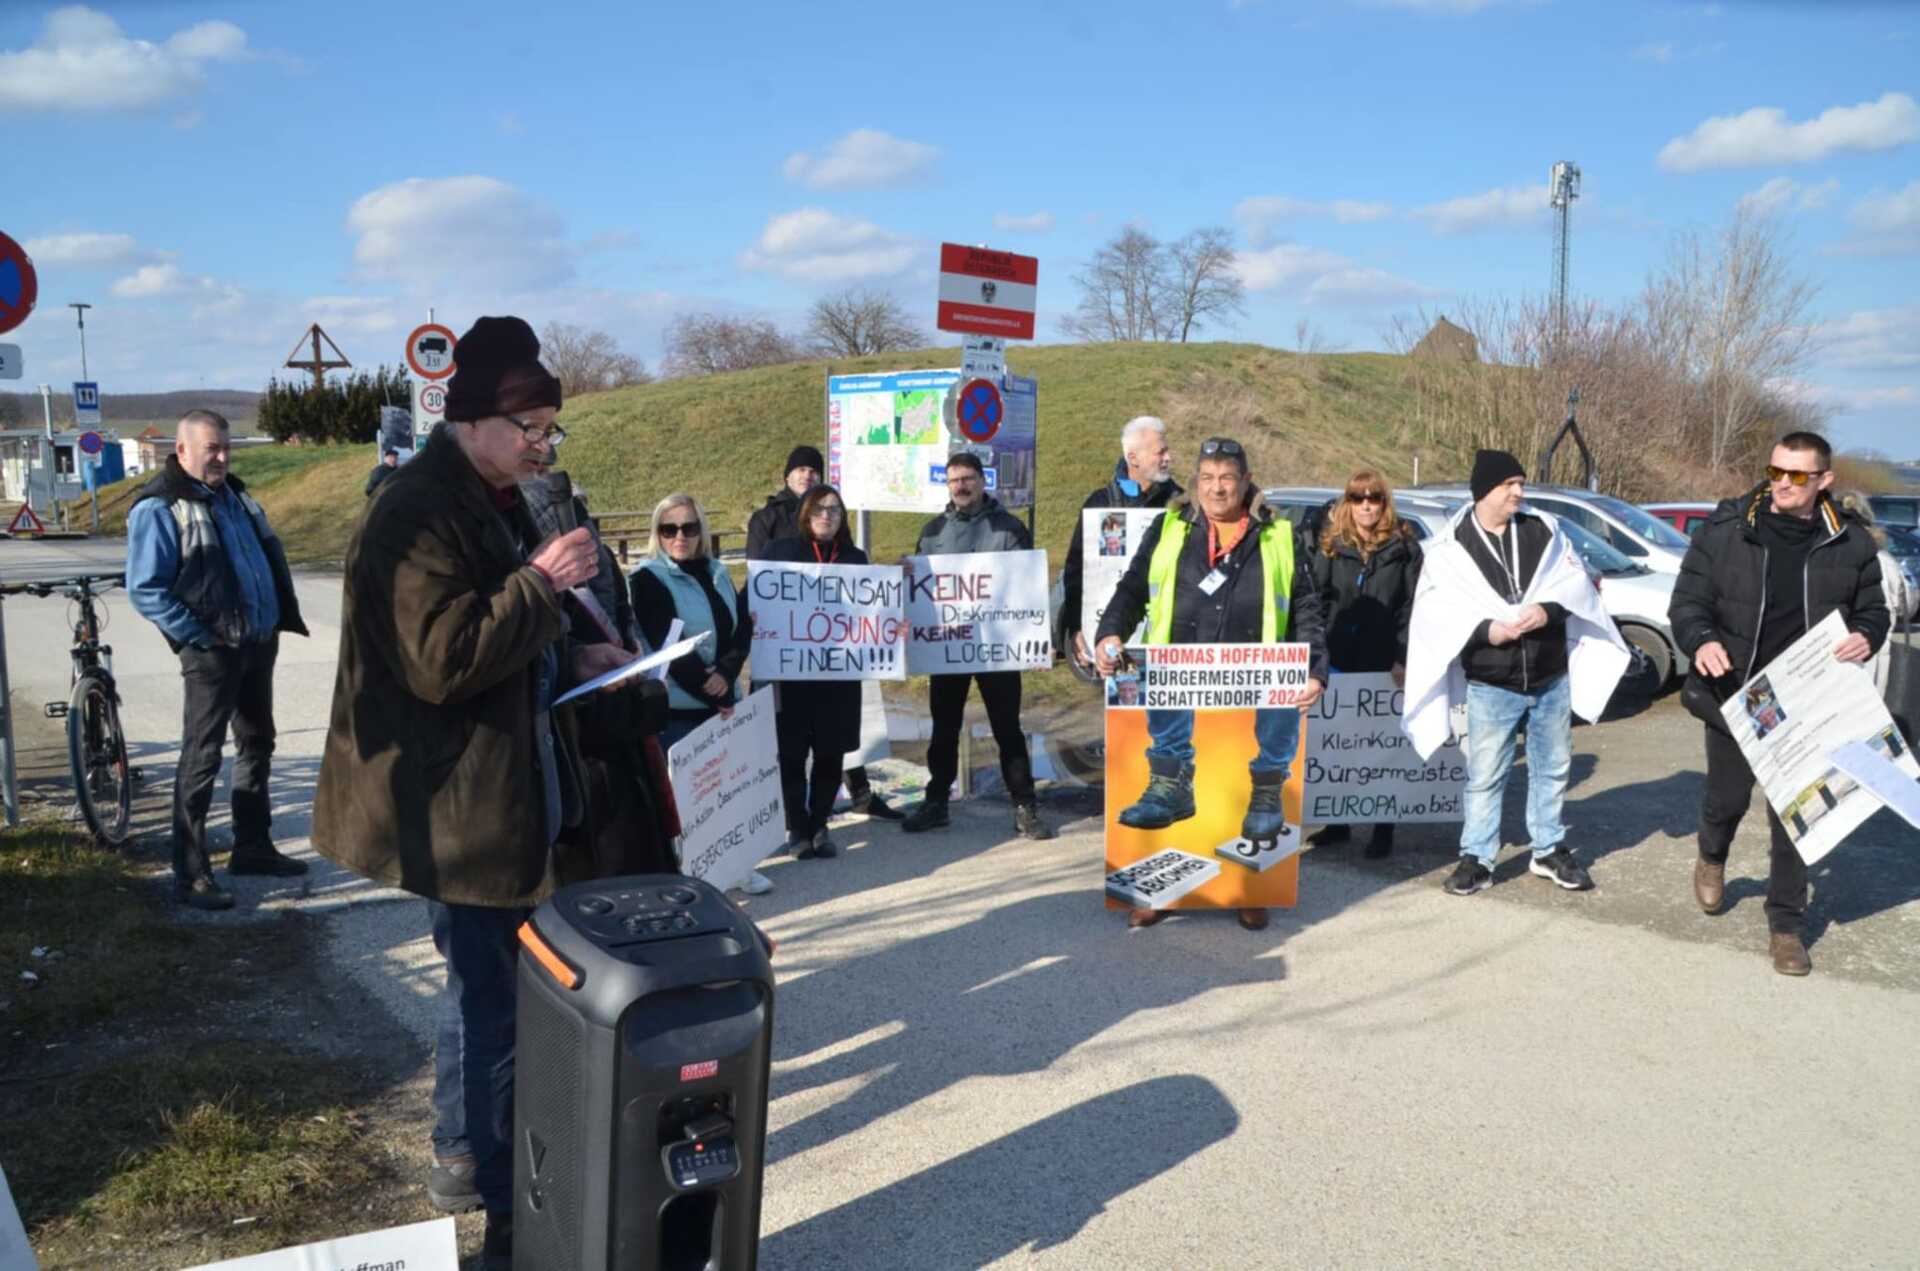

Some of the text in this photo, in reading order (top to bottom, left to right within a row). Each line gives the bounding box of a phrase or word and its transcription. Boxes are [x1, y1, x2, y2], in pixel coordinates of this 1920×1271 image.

[427, 392, 442, 407] 30
[909, 573, 992, 602] KEINE
[789, 606, 898, 645] LÖSUNG
[1149, 647, 1308, 665] THOMAS HOFFMANN
[1149, 666, 1307, 686] BÜRGERMEISTER VON
[1149, 688, 1305, 707] SCHATTENDORF 202
[1305, 757, 1469, 785] Bürgermeiste
[1135, 859, 1208, 897] ABKOMMEN
